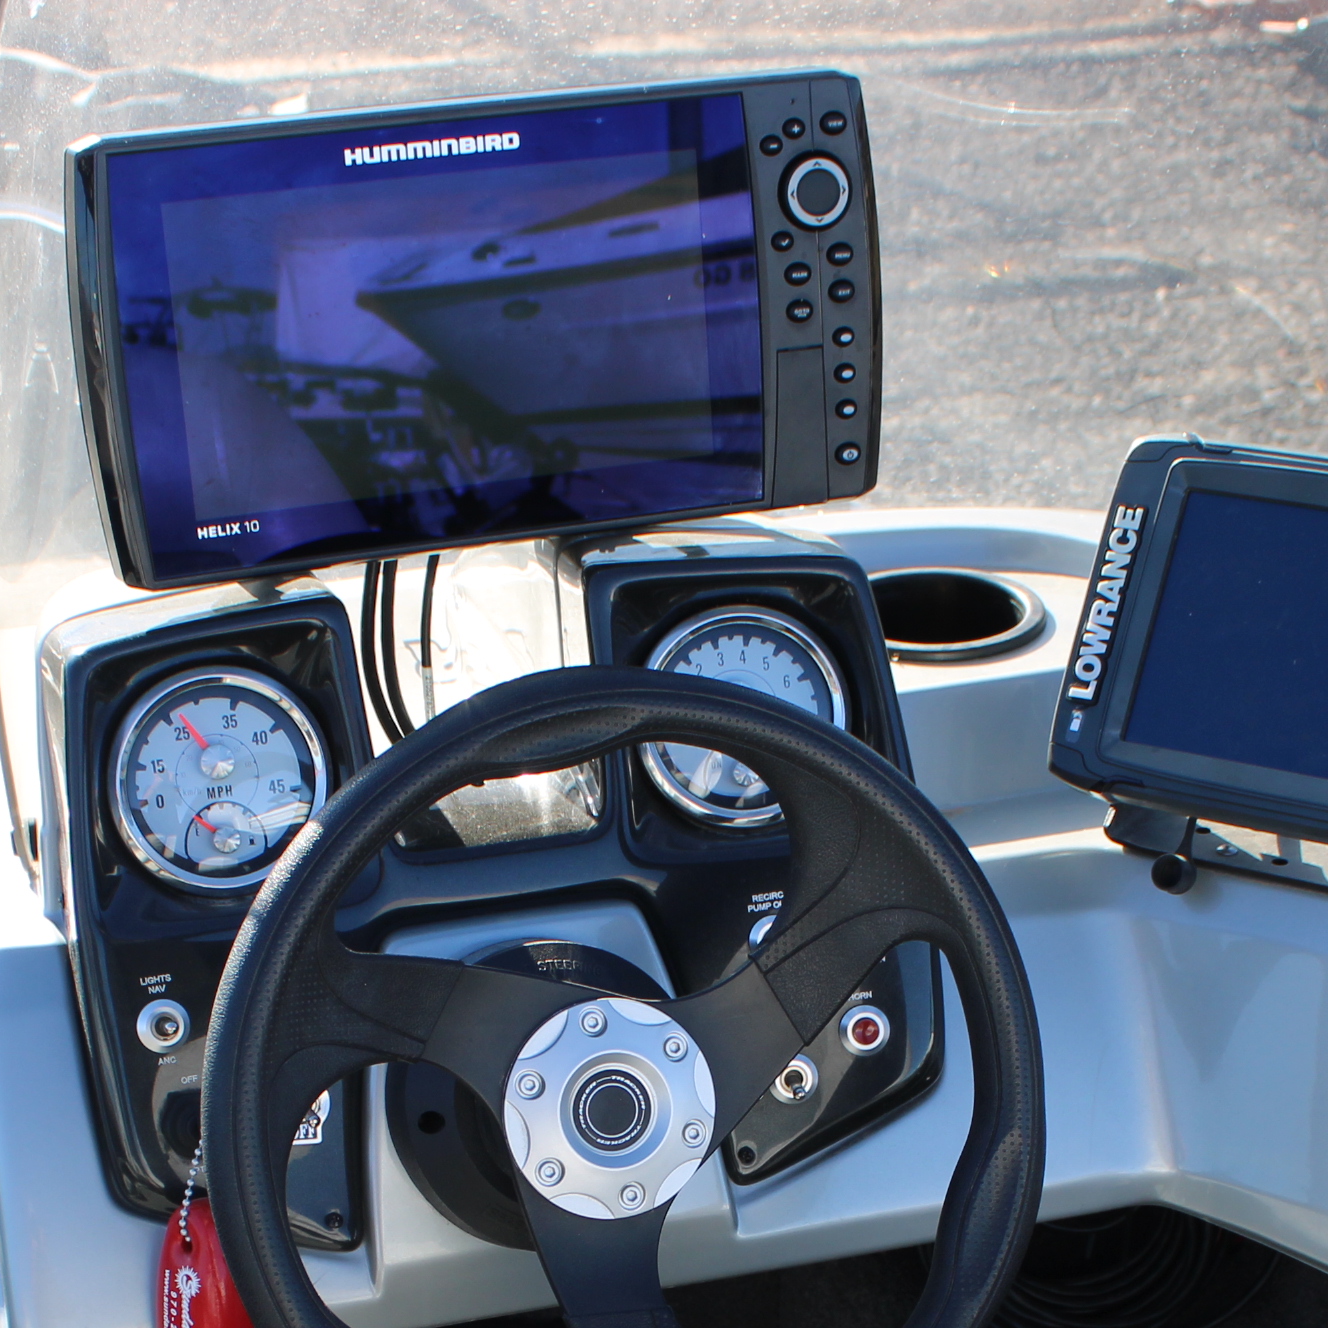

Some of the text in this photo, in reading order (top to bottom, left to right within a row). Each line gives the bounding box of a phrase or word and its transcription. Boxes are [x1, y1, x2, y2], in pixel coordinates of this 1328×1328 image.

[344, 132, 520, 166] HUMMINBIRD
[196, 520, 260, 540] HELIX 10
[1068, 504, 1145, 700] LOWRANCE
[717, 652, 725, 666] 3
[739, 650, 747, 664] 4
[762, 656, 770, 671] 5
[696, 663, 703, 677] 2
[783, 674, 791, 689] 6
[222, 714, 238, 730] 35
[174, 726, 190, 742] 25
[252, 730, 268, 746] 40
[150, 759, 165, 774] 15
[207, 785, 233, 799] MPH
[268, 779, 285, 794] 45
[155, 794, 165, 809] 0
[752, 890, 784, 902] RECIRC
[748, 902, 772, 912] PUMP
[140, 974, 172, 986] LIGHTS
[148, 984, 166, 994] NAV
[158, 1056, 176, 1066] ANC
[180, 1074, 198, 1084] OFF
[612, 1075, 646, 1110] TRACKER
[579, 1081, 596, 1129] TRACKER
[596, 1125, 642, 1146] TRACKER
